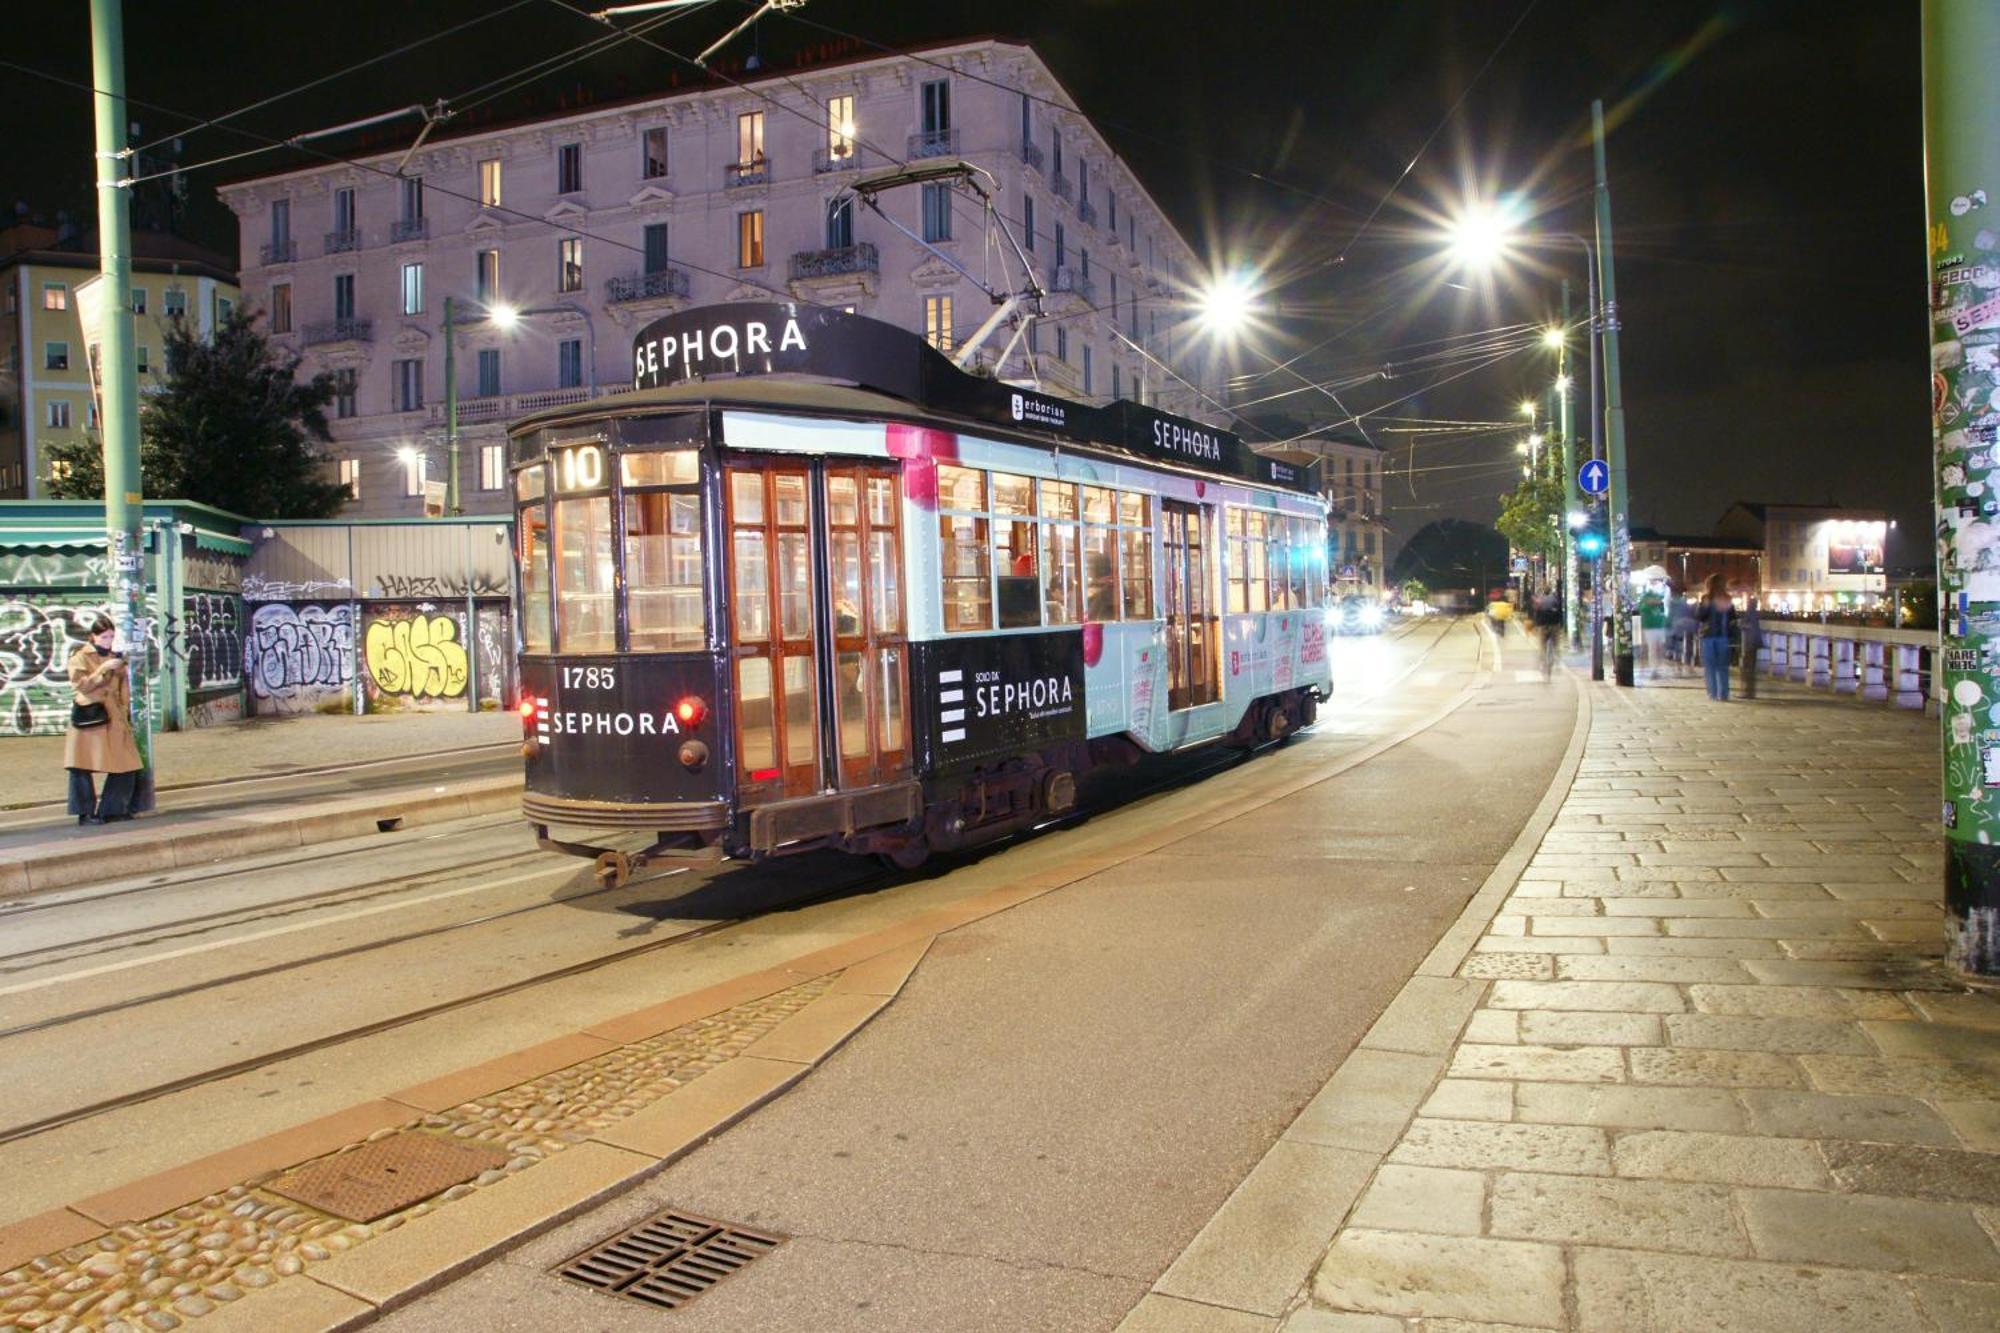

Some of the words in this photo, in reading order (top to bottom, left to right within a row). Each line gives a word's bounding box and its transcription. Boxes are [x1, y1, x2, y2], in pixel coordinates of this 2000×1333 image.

[635, 319, 808, 378] SEPHORA
[1153, 418, 1221, 462] SEPHORA
[563, 446, 602, 489] 10
[562, 666, 615, 690] 1785
[976, 675, 1073, 718] SEPHORA
[553, 711, 681, 736] SEPHORA
